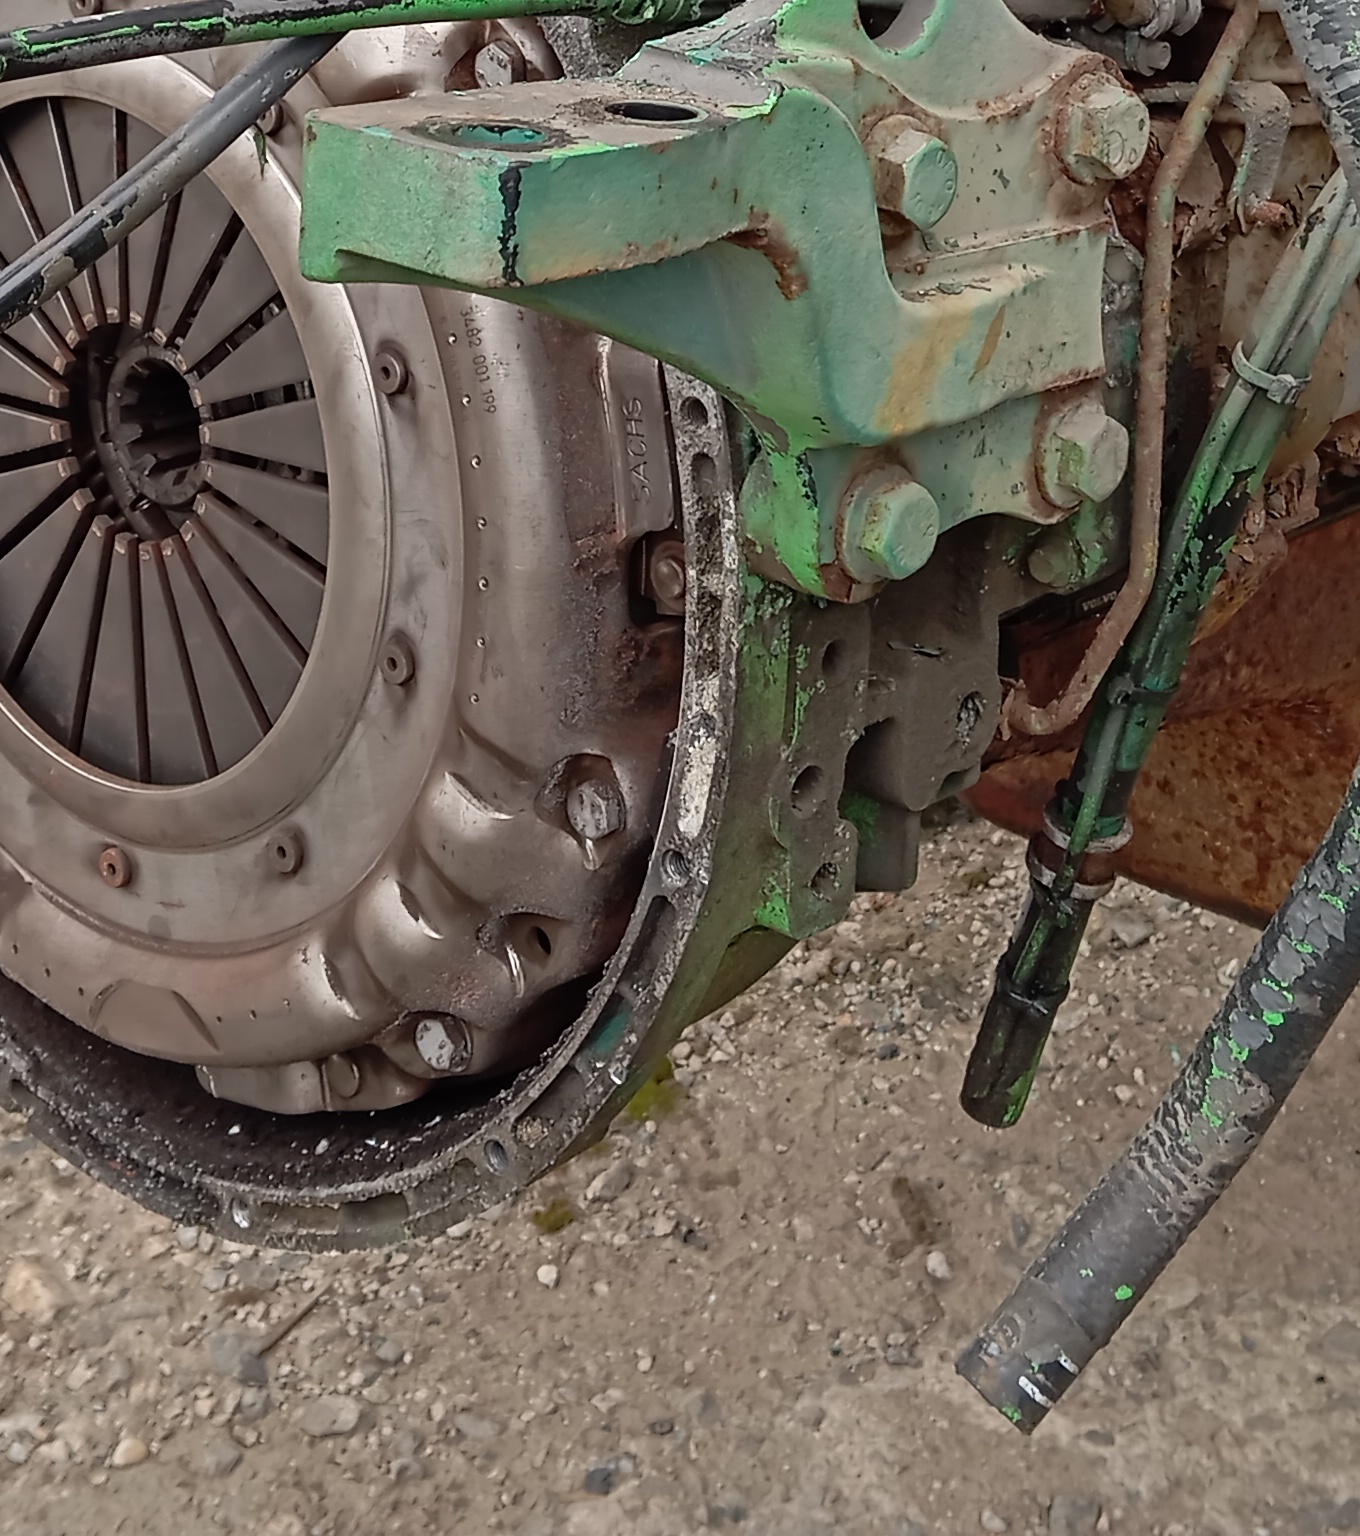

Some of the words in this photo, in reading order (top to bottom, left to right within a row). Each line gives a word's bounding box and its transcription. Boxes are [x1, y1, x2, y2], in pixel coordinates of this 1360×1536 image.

[460, 306, 482, 348] 3482
[472, 354, 490, 382] 001
[481, 388, 497, 414] 199
[622, 397, 652, 505] SACHS
